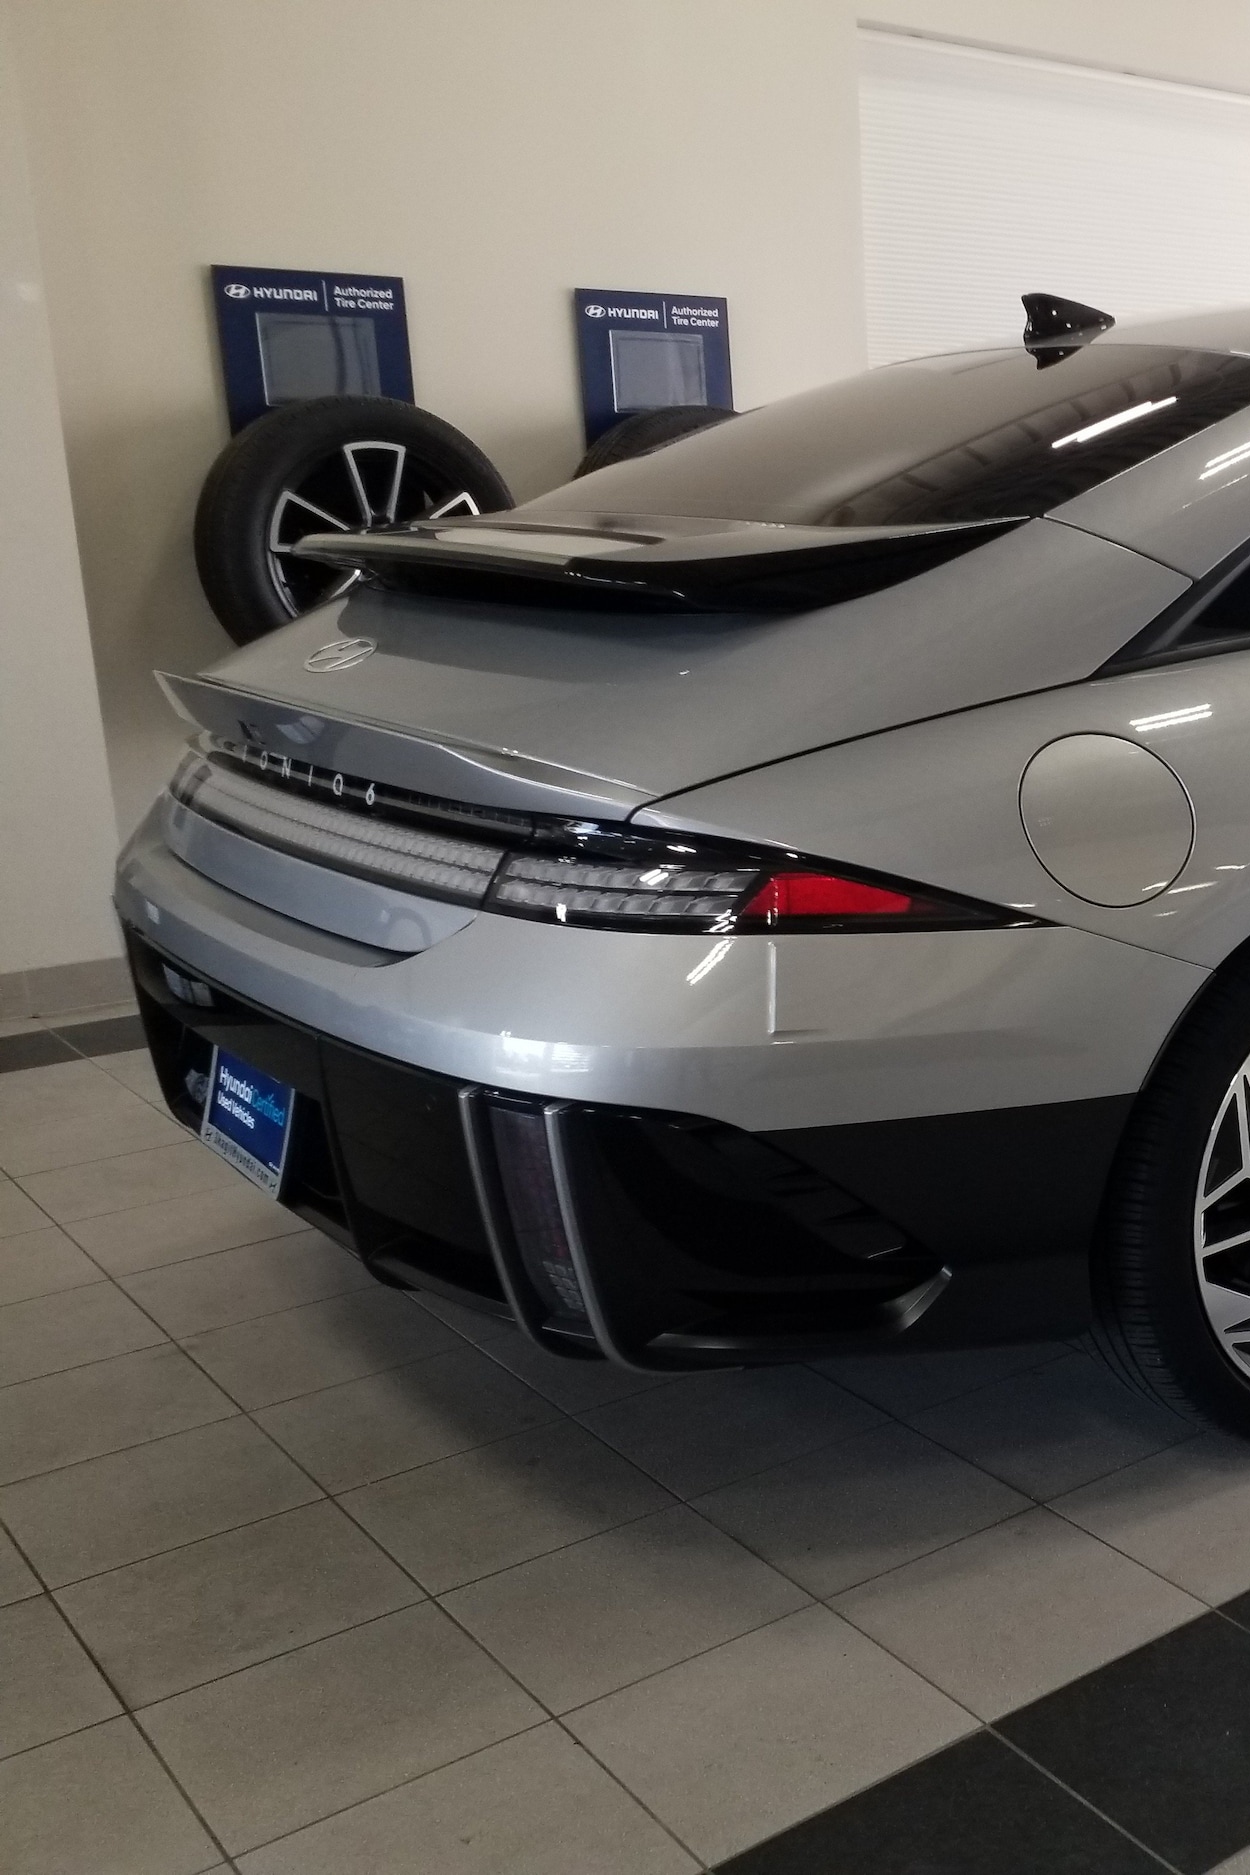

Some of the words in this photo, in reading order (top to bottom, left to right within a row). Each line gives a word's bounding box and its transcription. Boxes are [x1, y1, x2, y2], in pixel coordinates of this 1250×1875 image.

[253, 287, 318, 301] HYUNDAI
[334, 286, 393, 299] Authorized
[334, 297, 356, 308] Tire
[357, 298, 394, 310] Center
[608, 307, 659, 320] HYUNDAI
[671, 306, 719, 317] Authorized
[672, 316, 689, 325] Tire
[690, 317, 719, 327] Center
[365, 782, 375, 805] 6
[217, 1090, 232, 1112] Used
[231, 1101, 256, 1129] Vehicles
